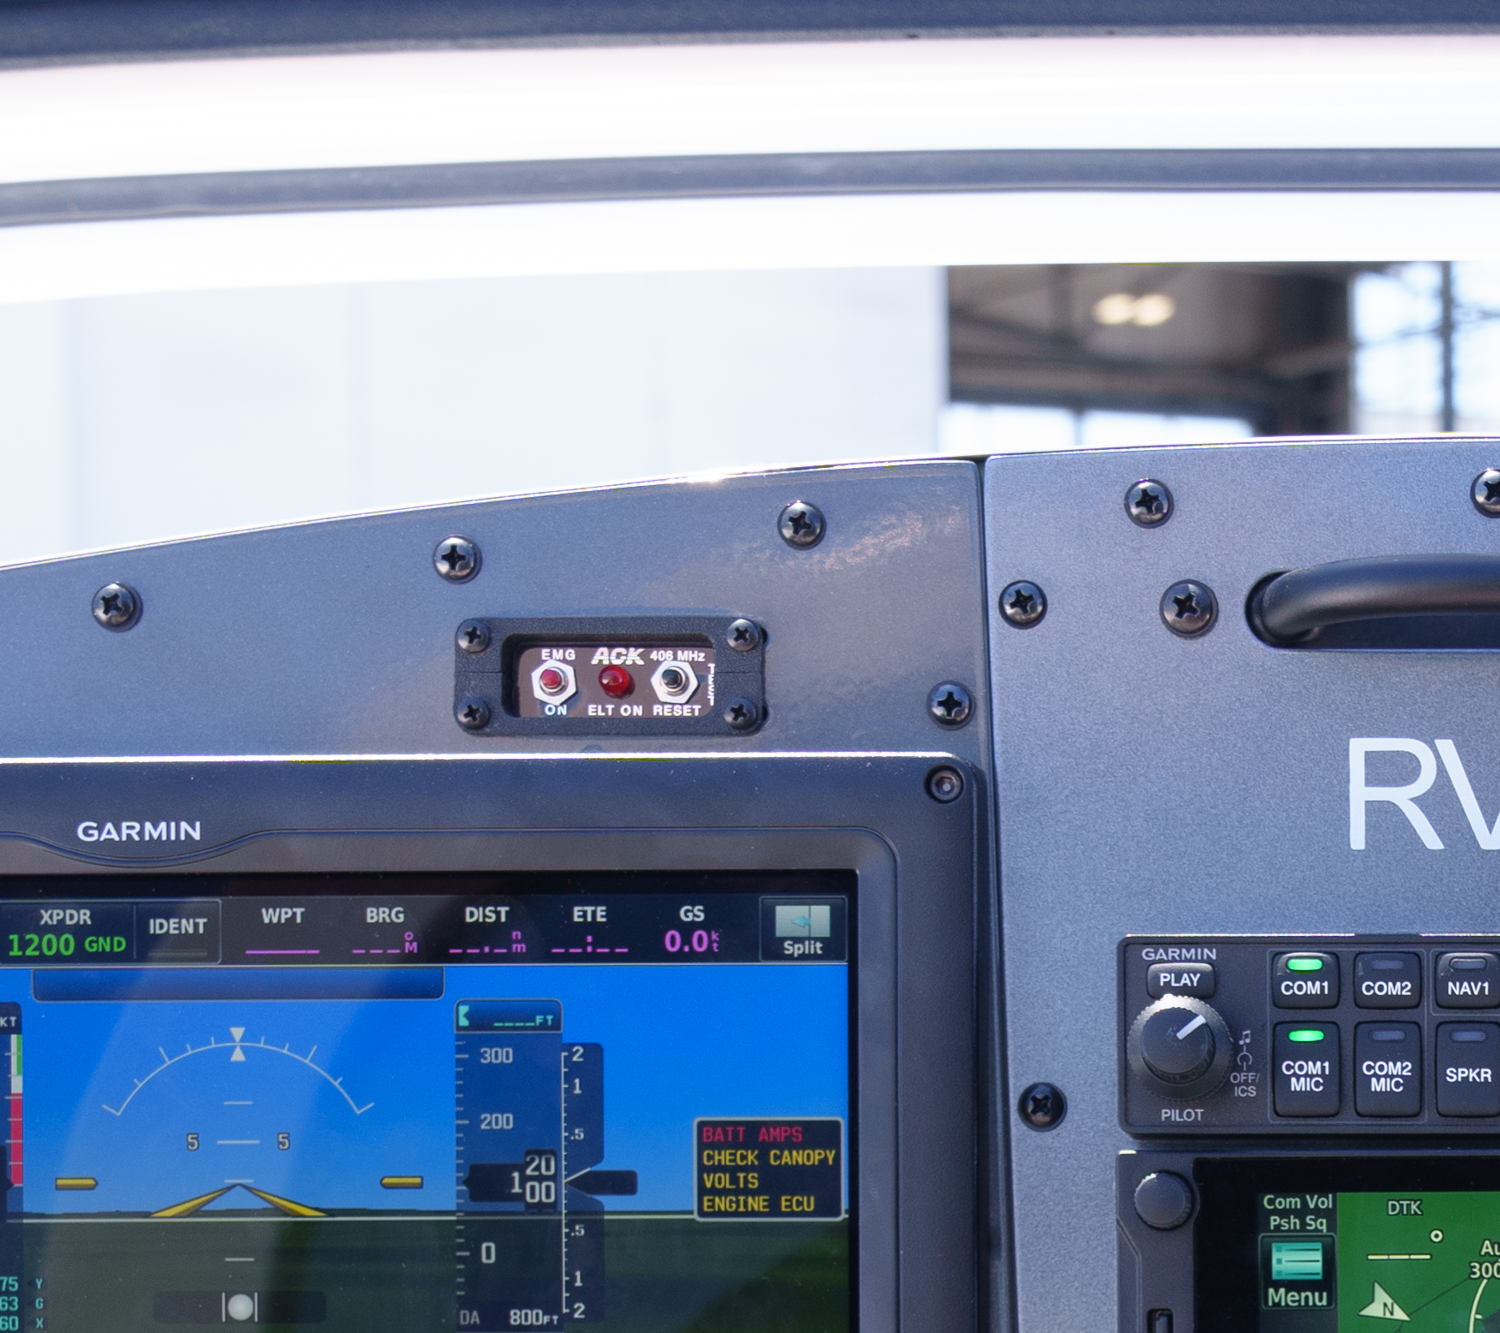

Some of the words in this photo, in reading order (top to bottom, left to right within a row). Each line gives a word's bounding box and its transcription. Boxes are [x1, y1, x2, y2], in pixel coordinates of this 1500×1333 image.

[542, 650, 576, 660] EMG
[591, 648, 644, 665] ACK
[650, 651, 673, 661] 406
[677, 651, 705, 661] MHz
[545, 705, 567, 715] ON
[588, 705, 614, 715] ELT
[620, 705, 642, 716] ON
[653, 705, 701, 716] RESET
[78, 821, 200, 841] GARMIN
[41, 911, 91, 926] XPDR
[262, 908, 305, 923] WPT
[464, 908, 509, 923] DIST
[150, 918, 207, 934] IDENT
[9, 933, 74, 956] 1200
[85, 937, 126, 952] GND
[783, 939, 823, 958] Split
[1142, 948, 1216, 960] GARMIN
[1159, 973, 1200, 988] PLAY
[1281, 981, 1328, 995] COM1
[1362, 981, 1411, 995] COM2
[1448, 982, 1488, 995] NAV1
[1446, 1068, 1491, 1082] SPKR
[1162, 1109, 1204, 1121] PILOT
[703, 1127, 745, 1142] BATT
[759, 1127, 802, 1142] AMPS
[703, 1150, 758, 1165] CHECK
[770, 1150, 835, 1165] CANOPY
[704, 1173, 758, 1188] VOLTS
[704, 1196, 769, 1211] ENGINE
[781, 1196, 814, 1211] ECU
[1269, 1288, 1327, 1306] Menu
